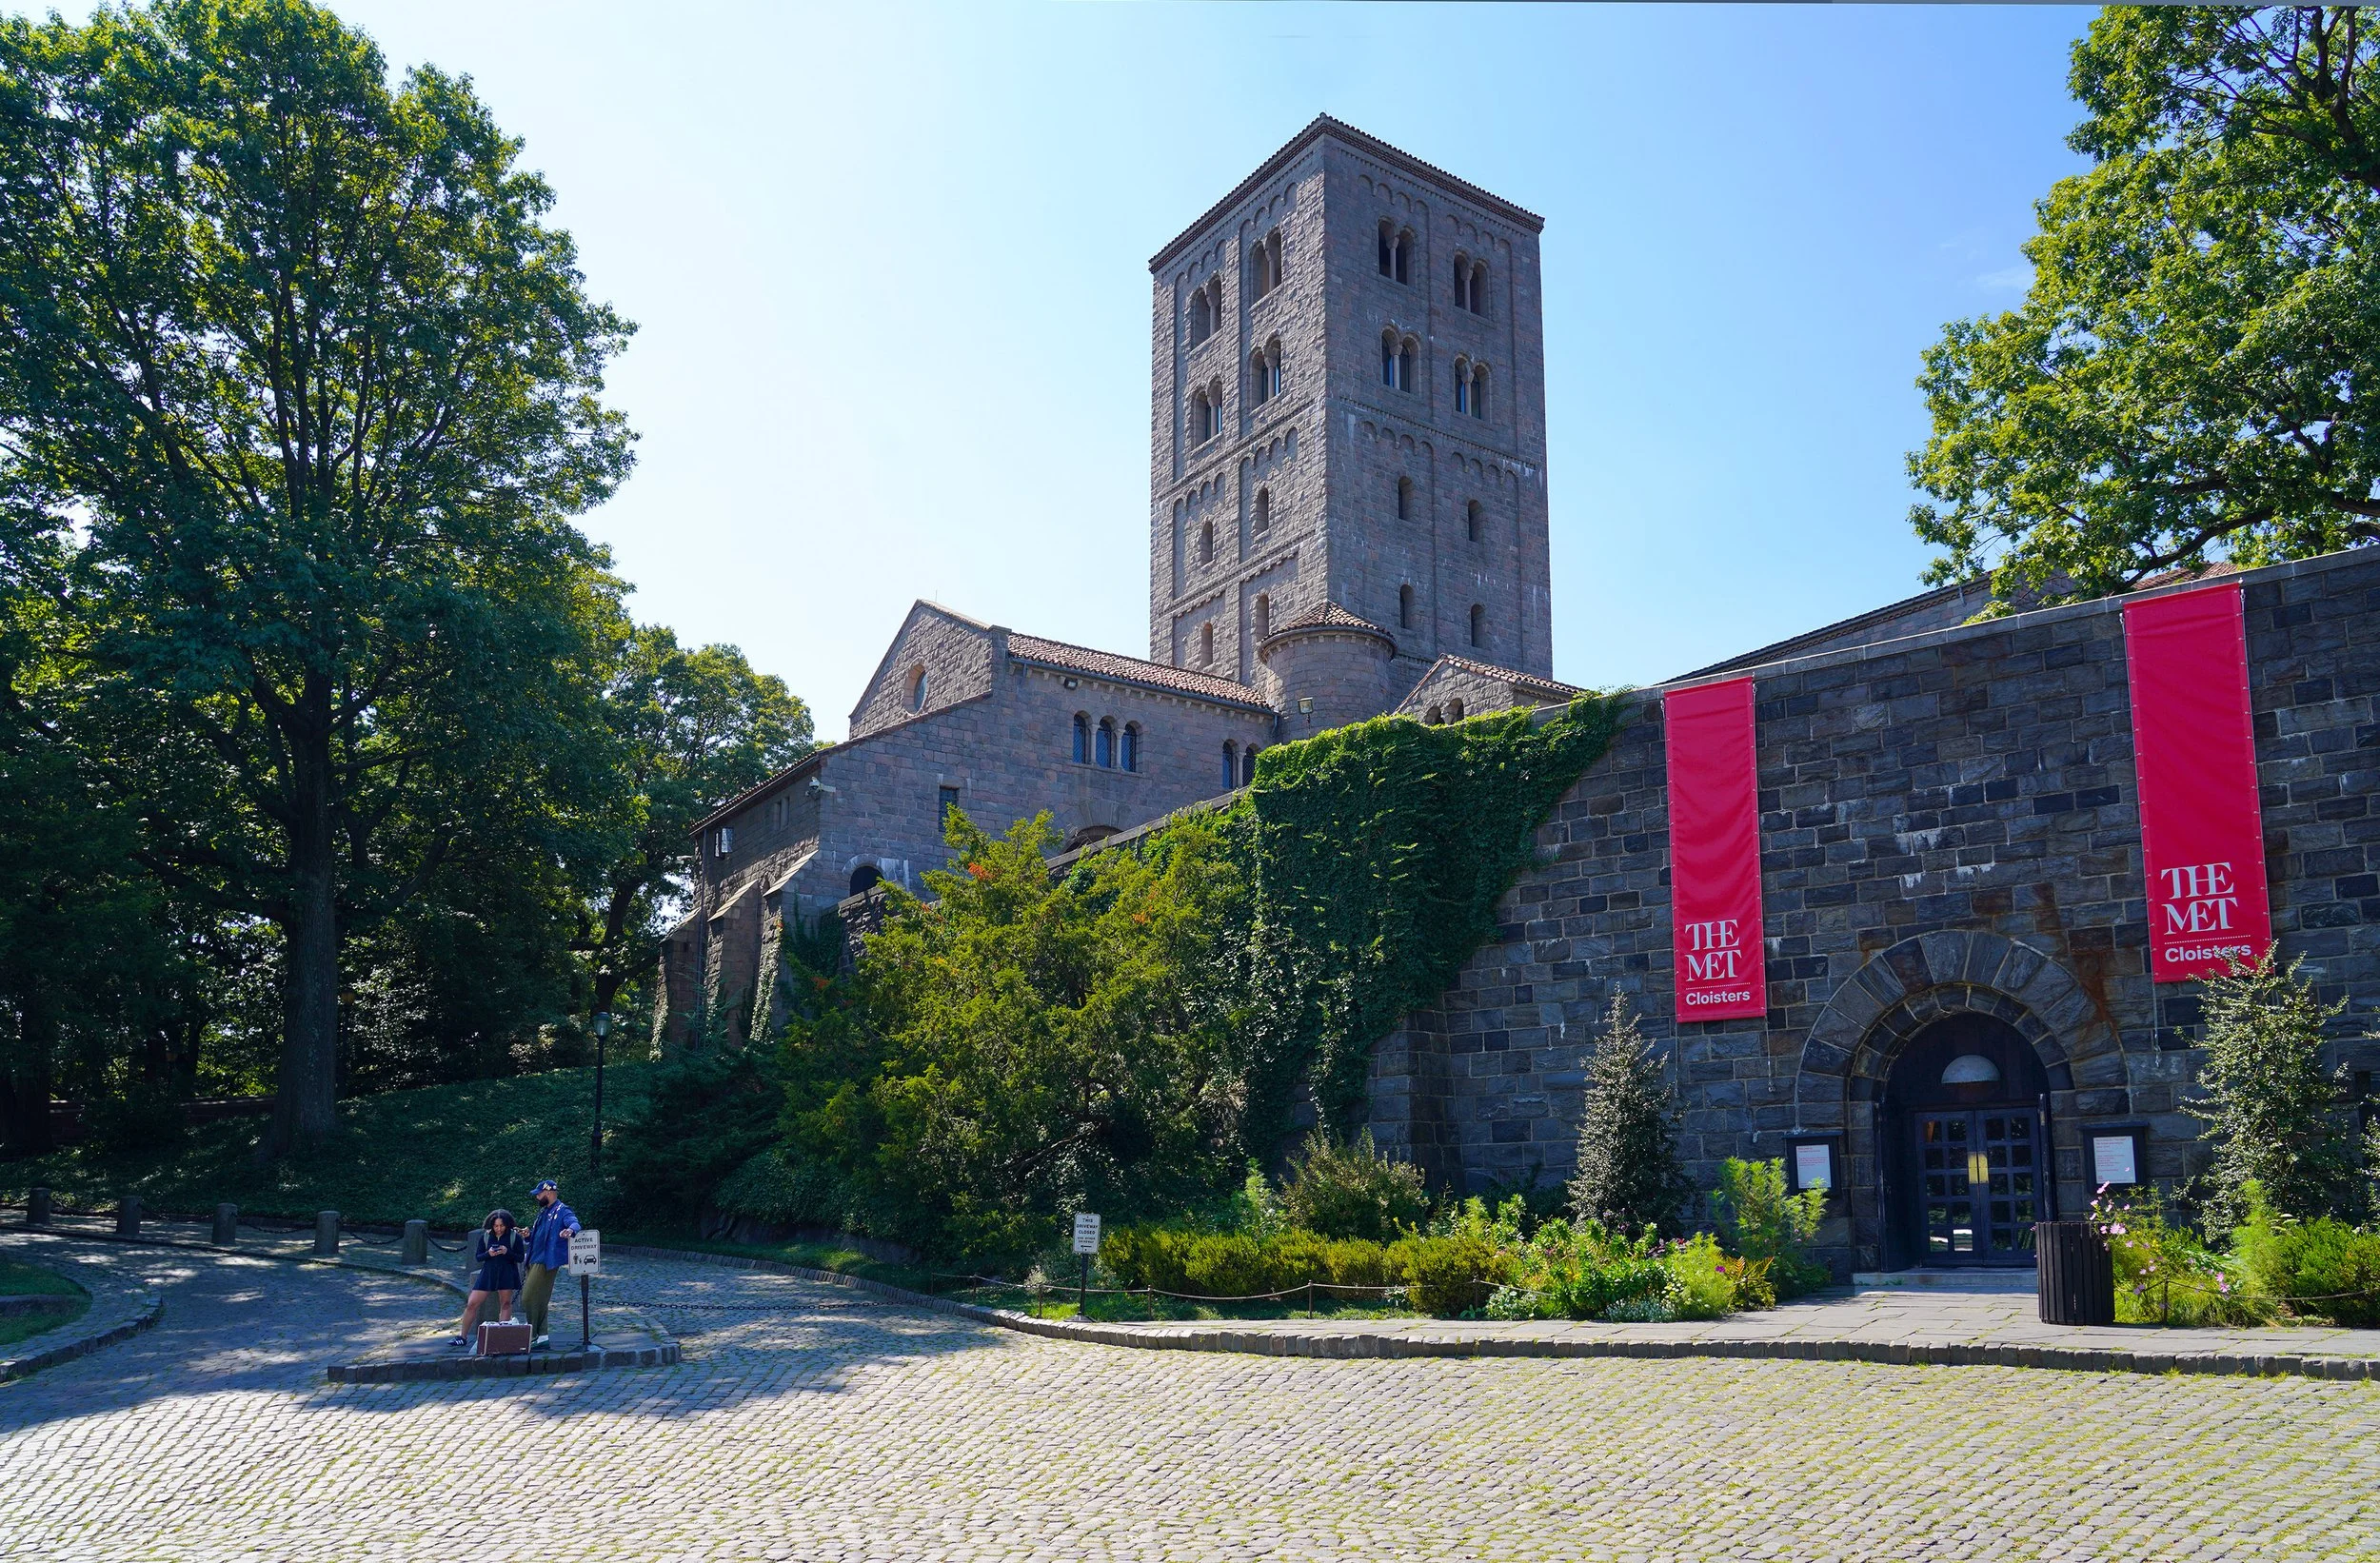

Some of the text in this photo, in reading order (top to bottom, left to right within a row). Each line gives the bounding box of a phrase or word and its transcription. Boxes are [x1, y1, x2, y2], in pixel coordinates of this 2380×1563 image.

[2160, 861, 2234, 900] THE
[2161, 897, 2239, 936] MET
[1685, 919, 1740, 951] THE
[1685, 949, 1742, 982] MET
[1685, 990, 1751, 1006] Cloisters
